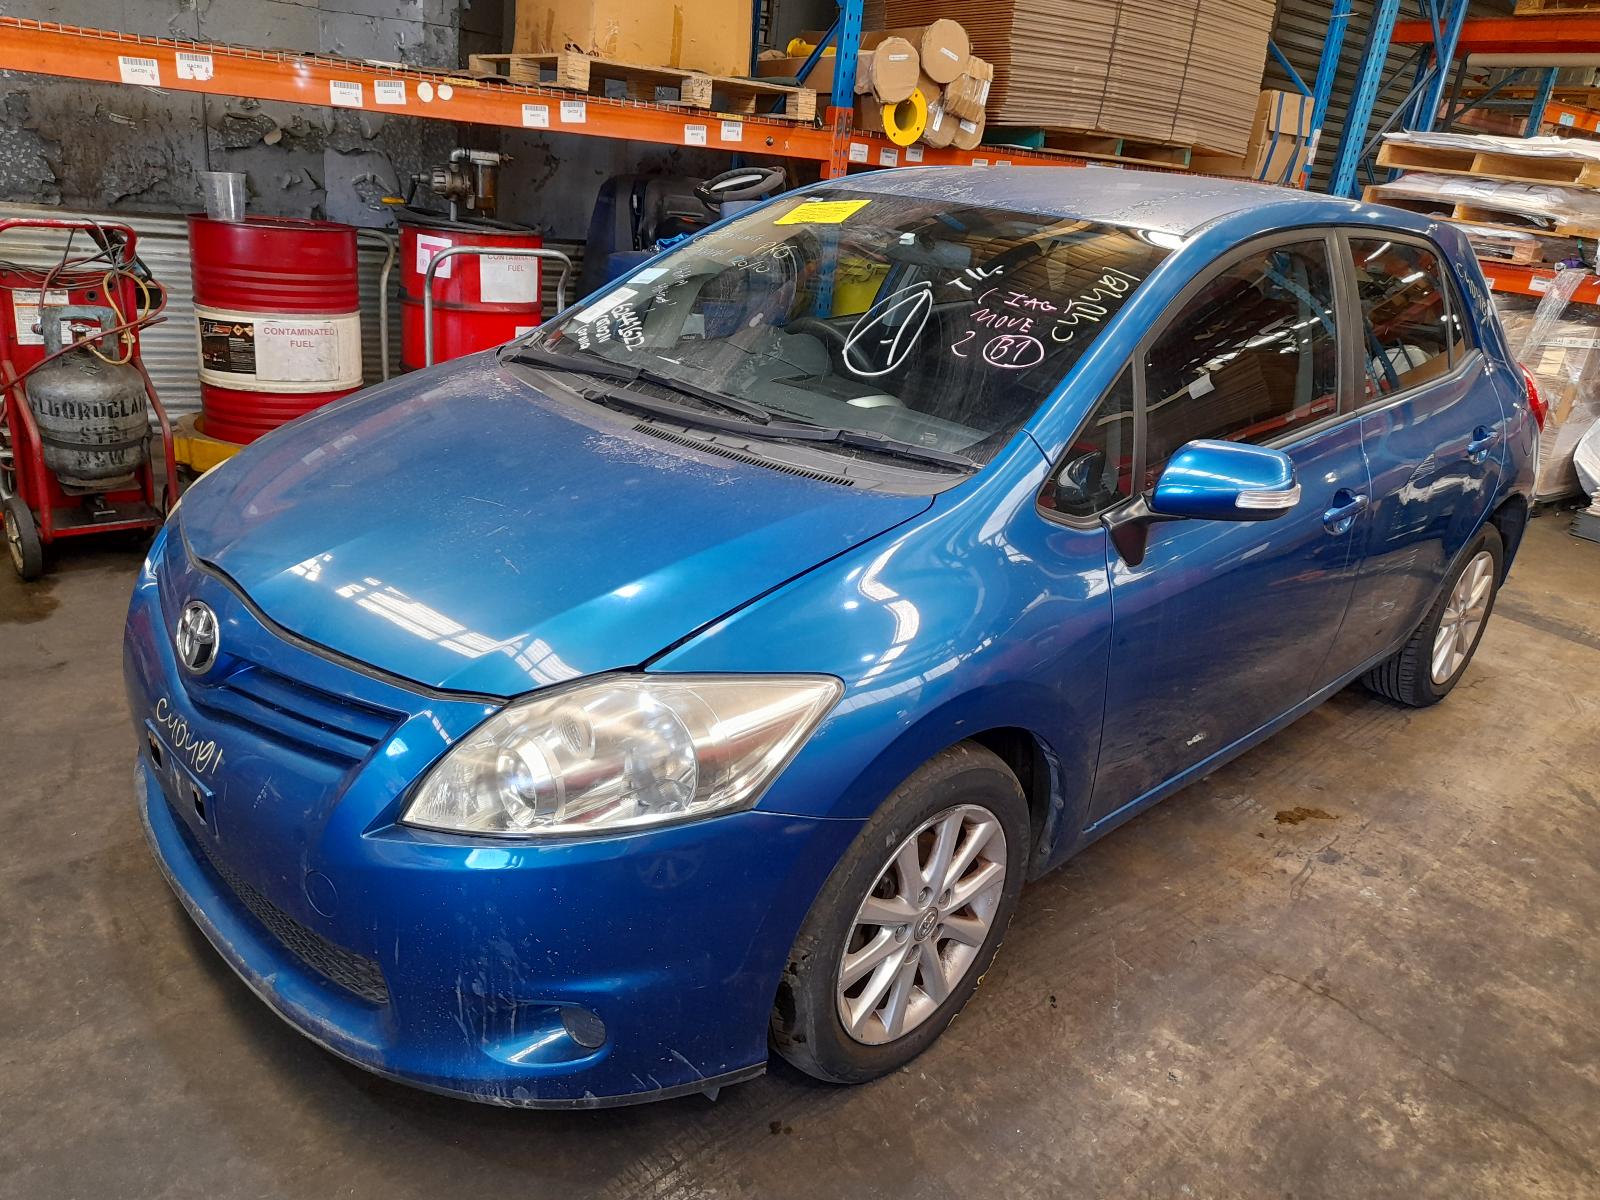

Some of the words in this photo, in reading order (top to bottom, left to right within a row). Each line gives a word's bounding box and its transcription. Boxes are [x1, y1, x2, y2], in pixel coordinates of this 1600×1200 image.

[507, 264, 525, 272] FUEL
[969, 308, 1036, 335] MOVE
[264, 327, 335, 336] CONTAMINATED
[289, 340, 315, 348] FUEL
